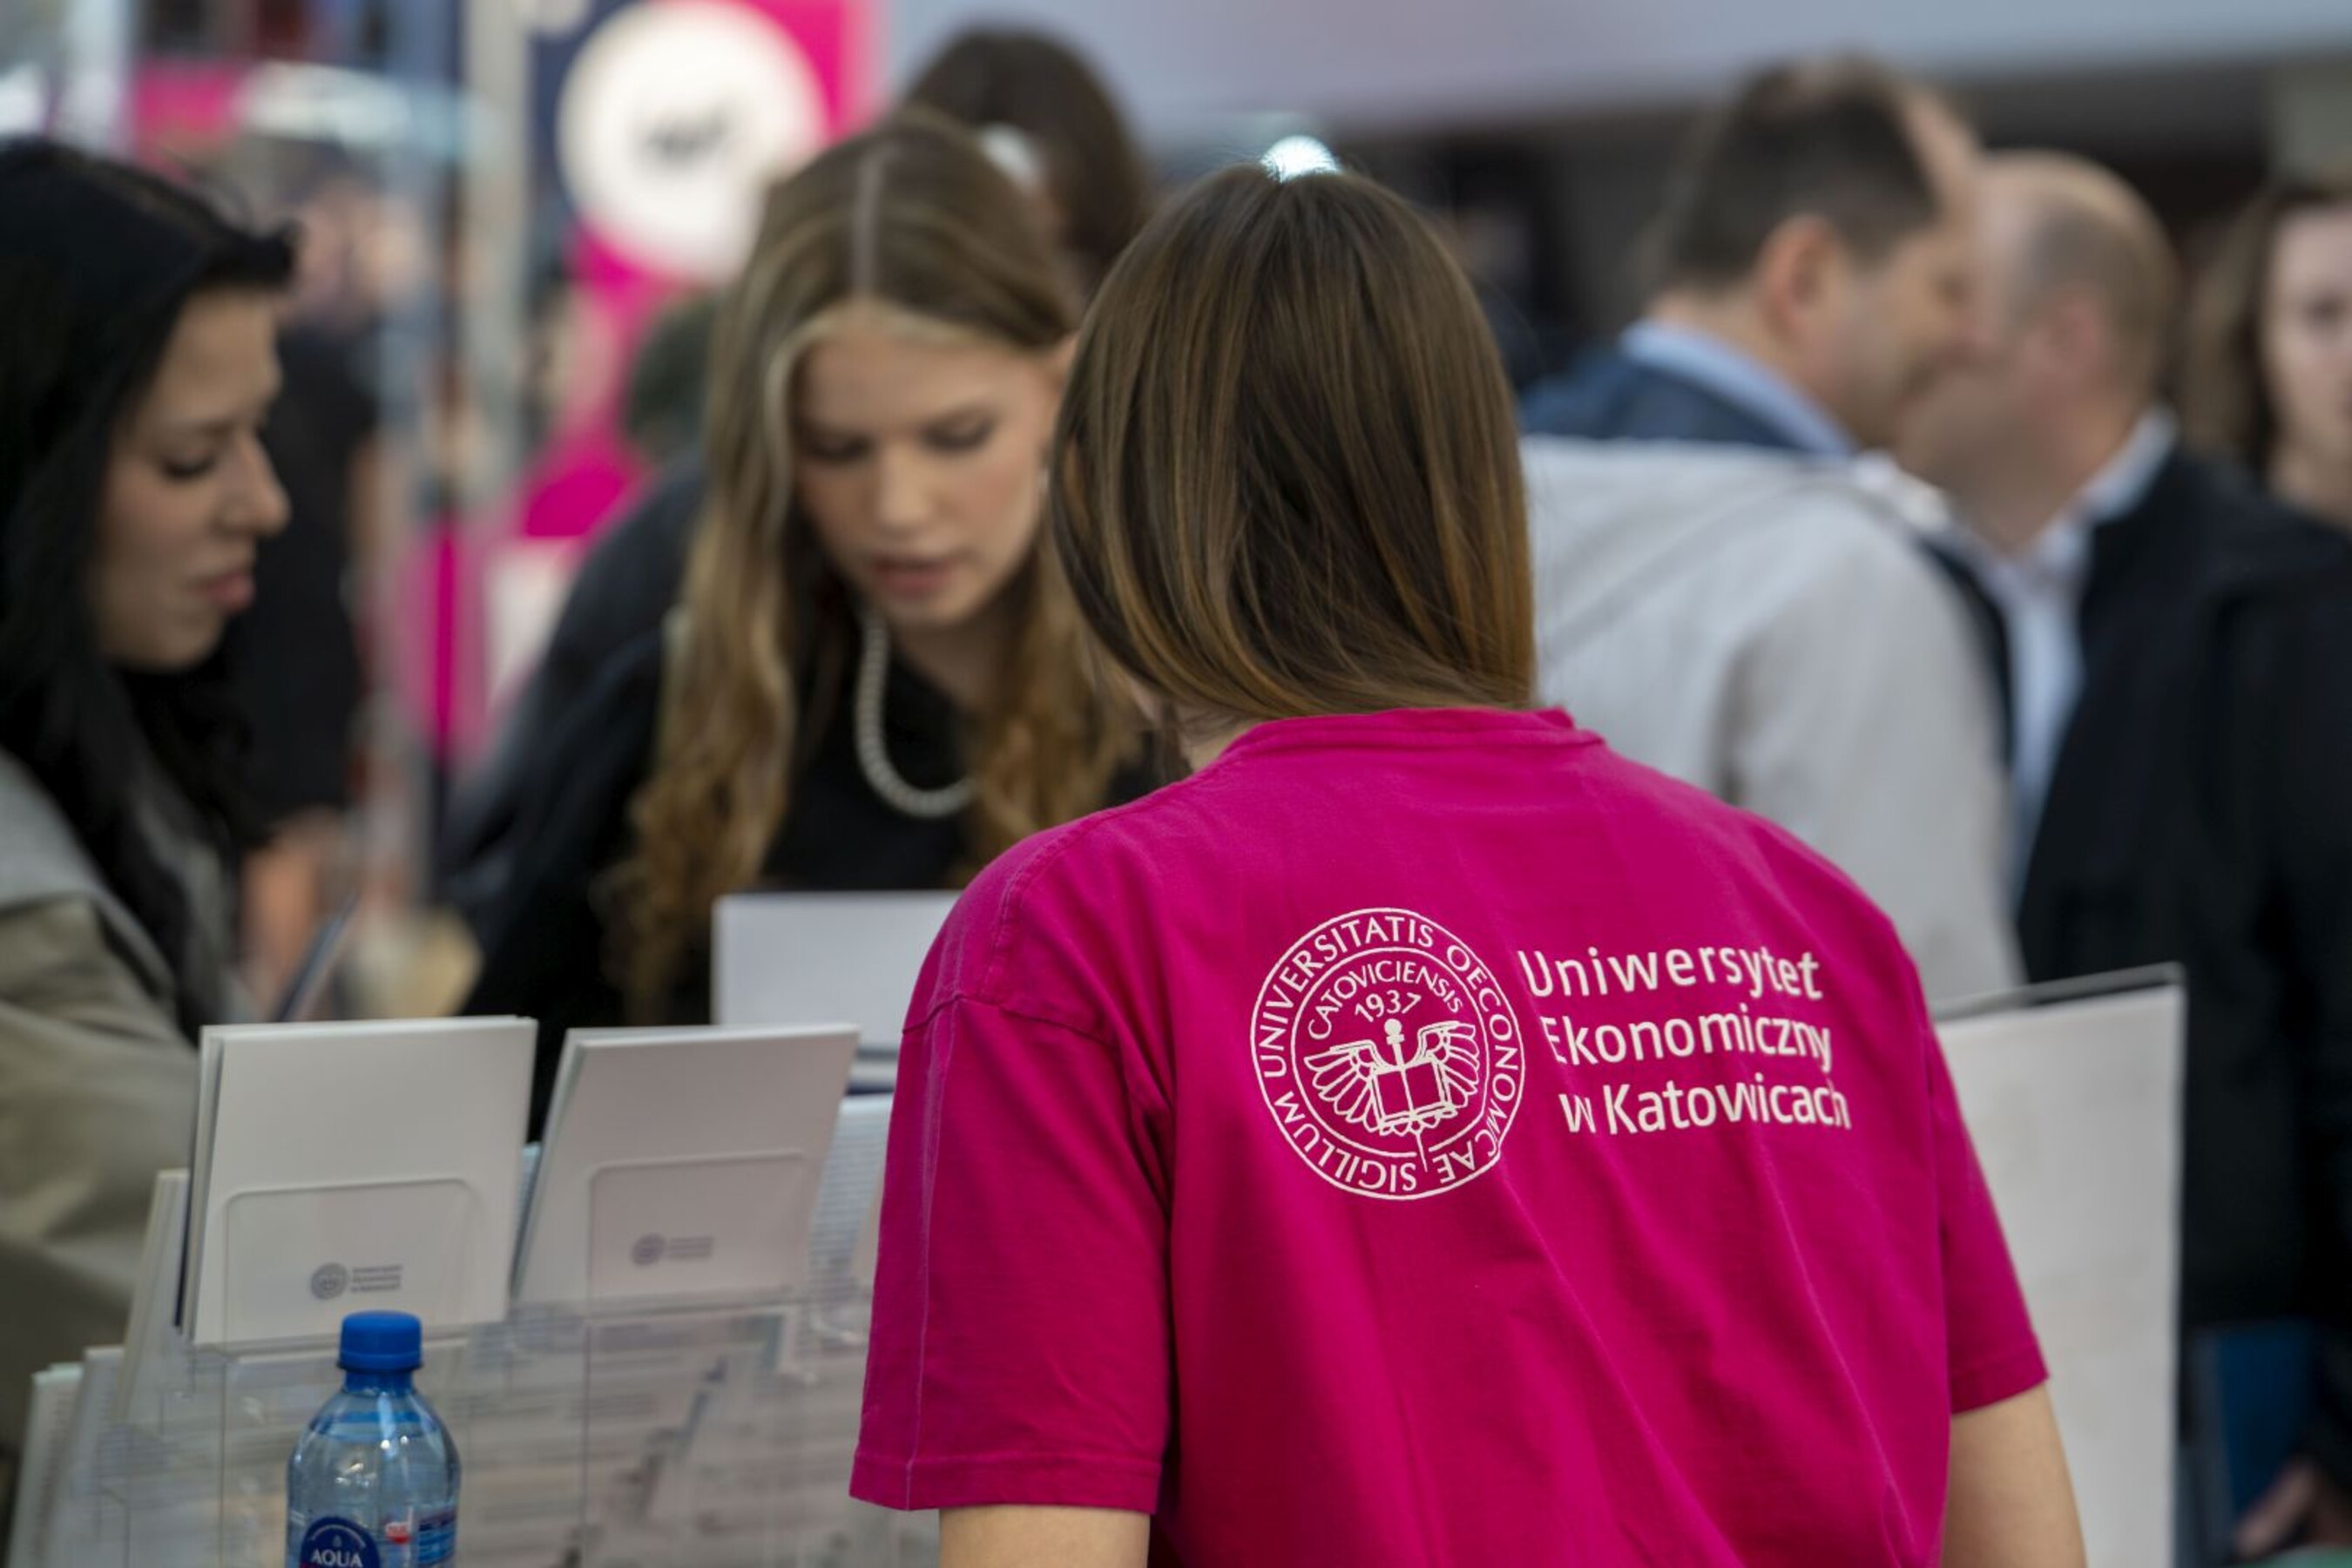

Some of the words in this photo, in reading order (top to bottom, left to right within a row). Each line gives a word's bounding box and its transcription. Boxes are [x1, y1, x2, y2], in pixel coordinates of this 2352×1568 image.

[1259, 916, 1435, 1078] UNIVERSITATIS
[1308, 960, 1463, 1040] CATOVICIENSIS
[1517, 946, 1823, 1000] Uniwersytet
[1355, 990, 1422, 1023] 1937
[1539, 1003, 1832, 1073] Ekonomiczny
[1603, 1072, 1852, 1135] Katowicach
[1274, 1091, 1417, 1193] SIGILLUM
[311, 1549, 363, 1567] AQUA
